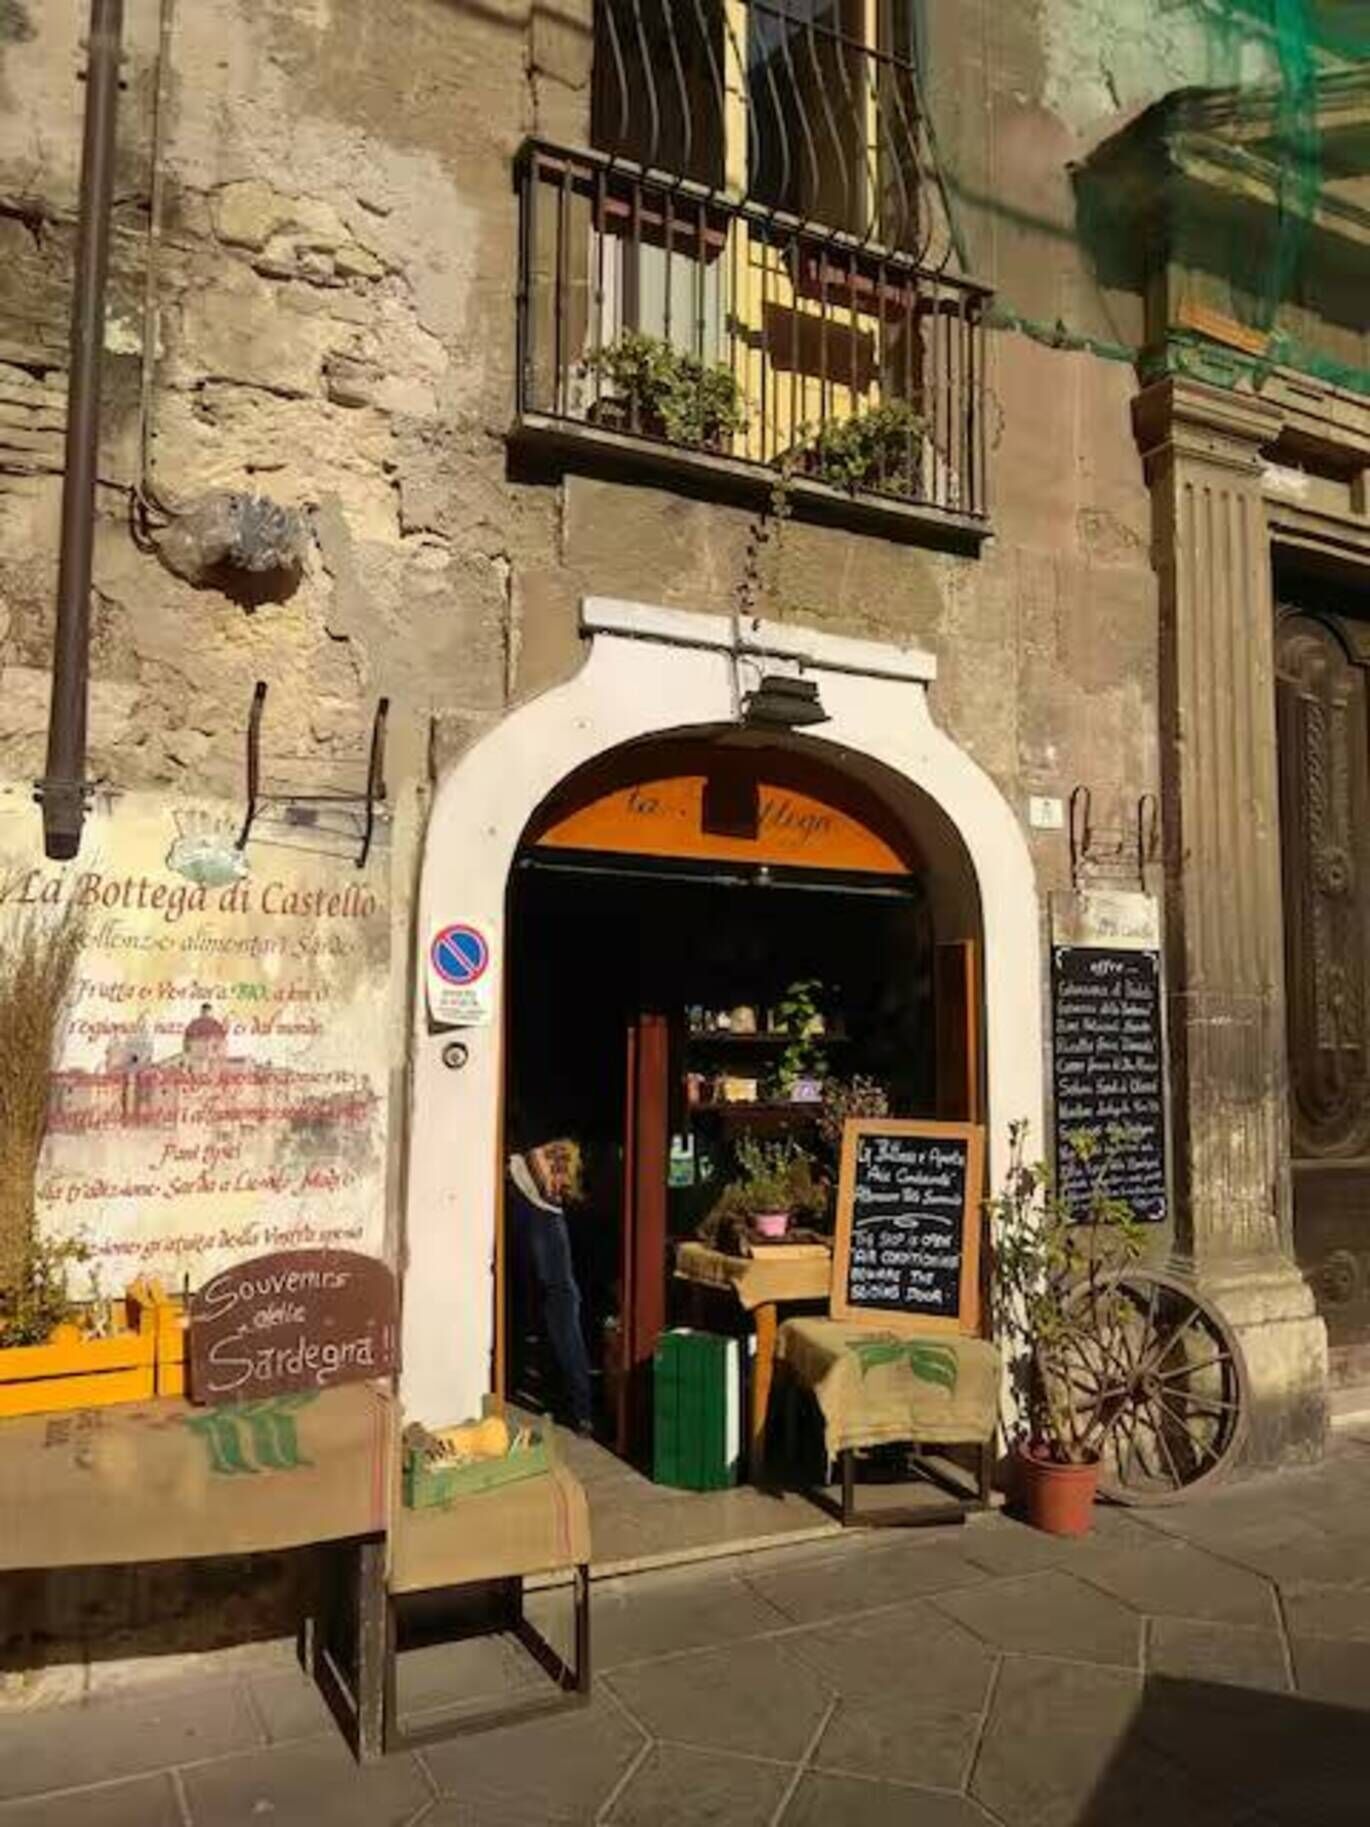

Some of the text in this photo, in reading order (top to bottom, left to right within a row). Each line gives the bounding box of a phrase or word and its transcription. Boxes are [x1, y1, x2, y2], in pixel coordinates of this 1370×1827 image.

[76, 872, 207, 924] Bottega
[219, 876, 251, 914] di
[261, 881, 376, 918] Castello
[193, 1272, 352, 1322] Souvenirs
[208, 1333, 374, 1391] Sardegna
